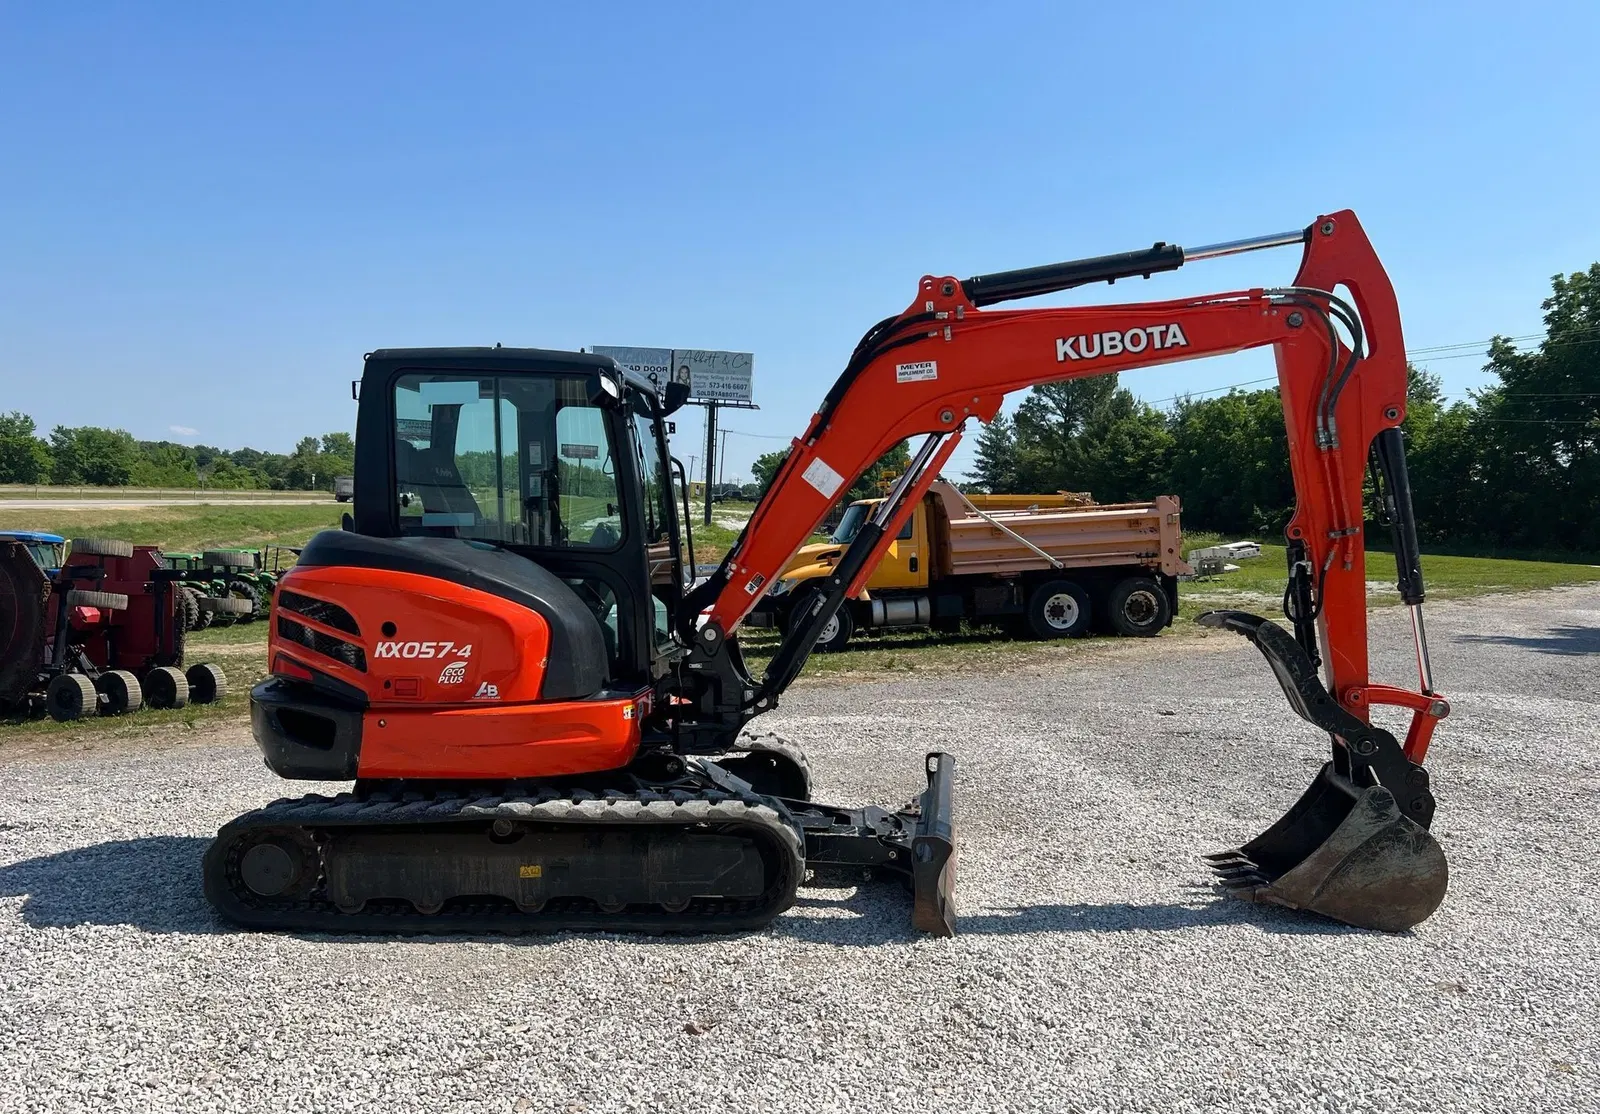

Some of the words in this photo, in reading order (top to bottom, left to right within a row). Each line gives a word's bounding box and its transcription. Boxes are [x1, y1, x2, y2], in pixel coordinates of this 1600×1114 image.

[1055, 323, 1188, 362] KUBOTA
[678, 350, 719, 368] Abbott
[643, 365, 668, 373] DOOR
[900, 362, 932, 370] MEYER
[374, 641, 472, 659] KX057-4
[445, 667, 465, 676] eco
[437, 675, 464, 684] PLUS
